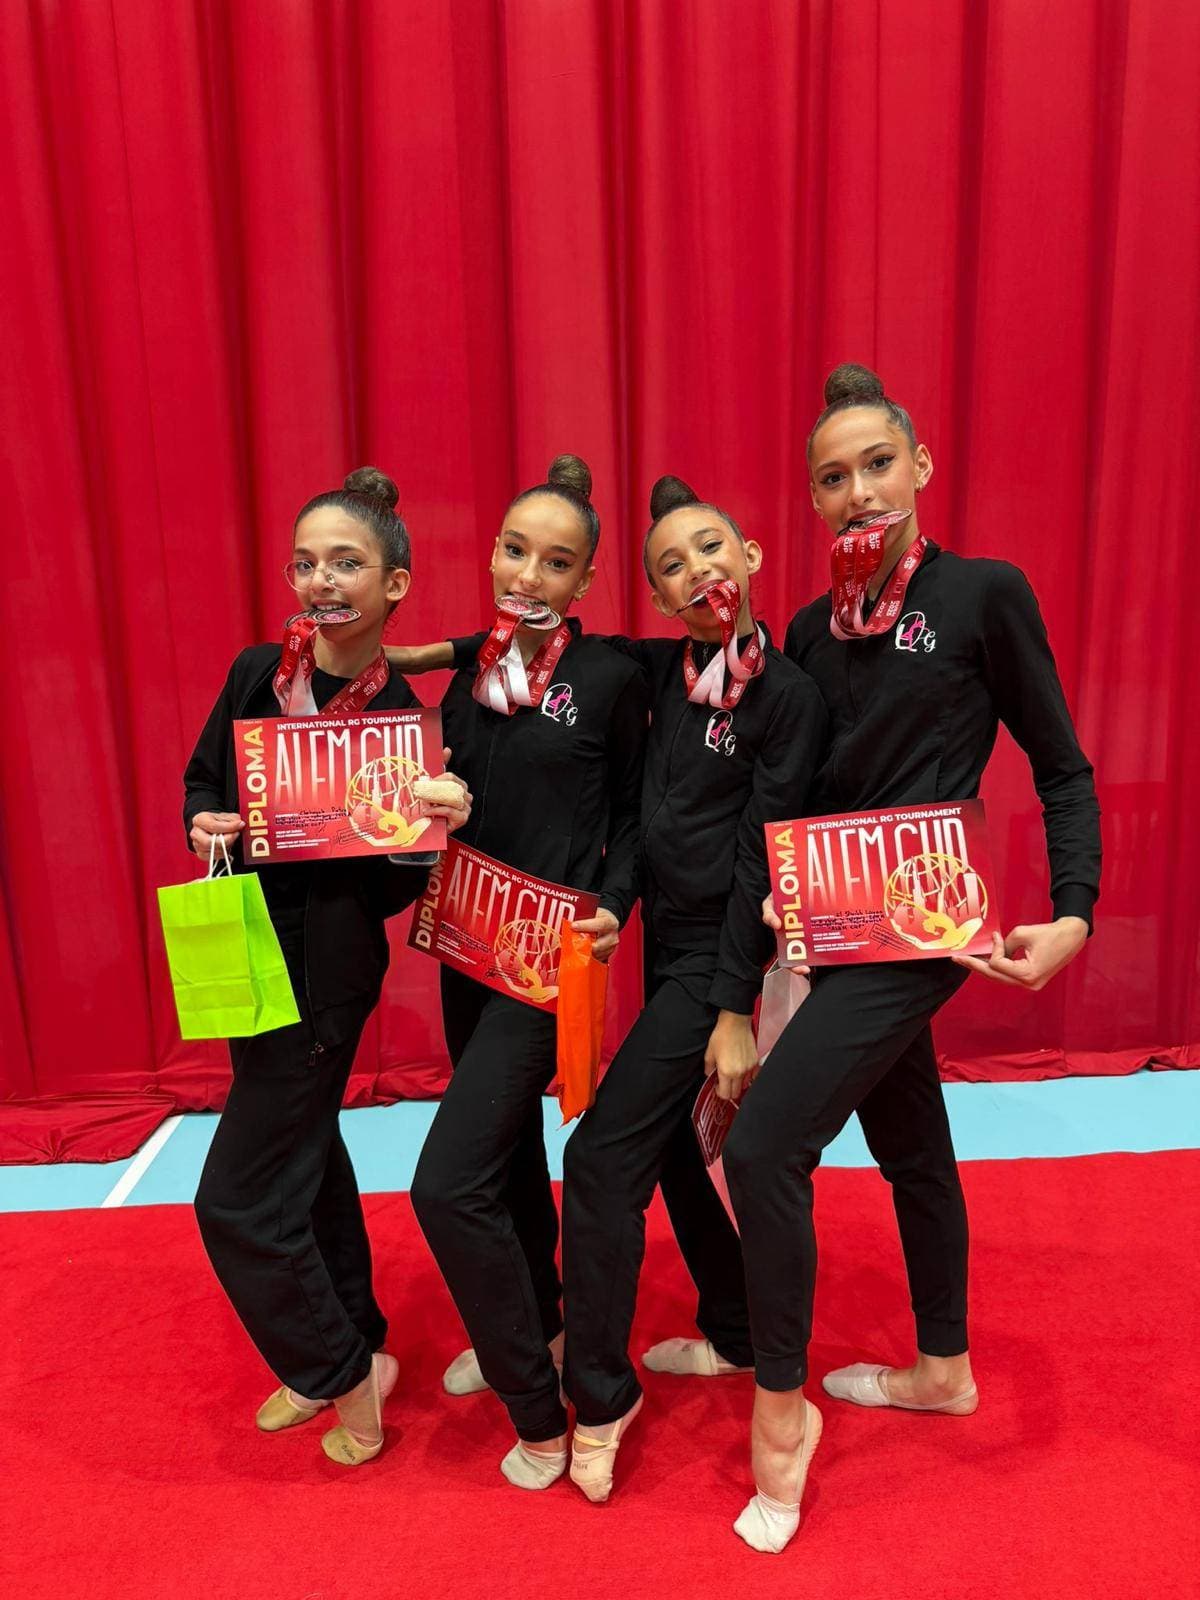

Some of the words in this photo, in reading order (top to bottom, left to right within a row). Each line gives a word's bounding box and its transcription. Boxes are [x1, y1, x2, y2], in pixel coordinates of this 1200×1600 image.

[349, 681, 361, 693] CUP
[277, 719, 346, 731] INTERNATIONAL
[361, 714, 422, 724] TOURNAMENT
[243, 726, 270, 858] DIPLOMA
[807, 815, 878, 832] INTERNATIONAL
[880, 814, 894, 823] RG
[895, 807, 962, 821] TOURNAMENT
[458, 848, 511, 879] INTERNATIONAL
[523, 879, 580, 903] TOURNAMENT
[774, 828, 808, 961] DIPLOMA
